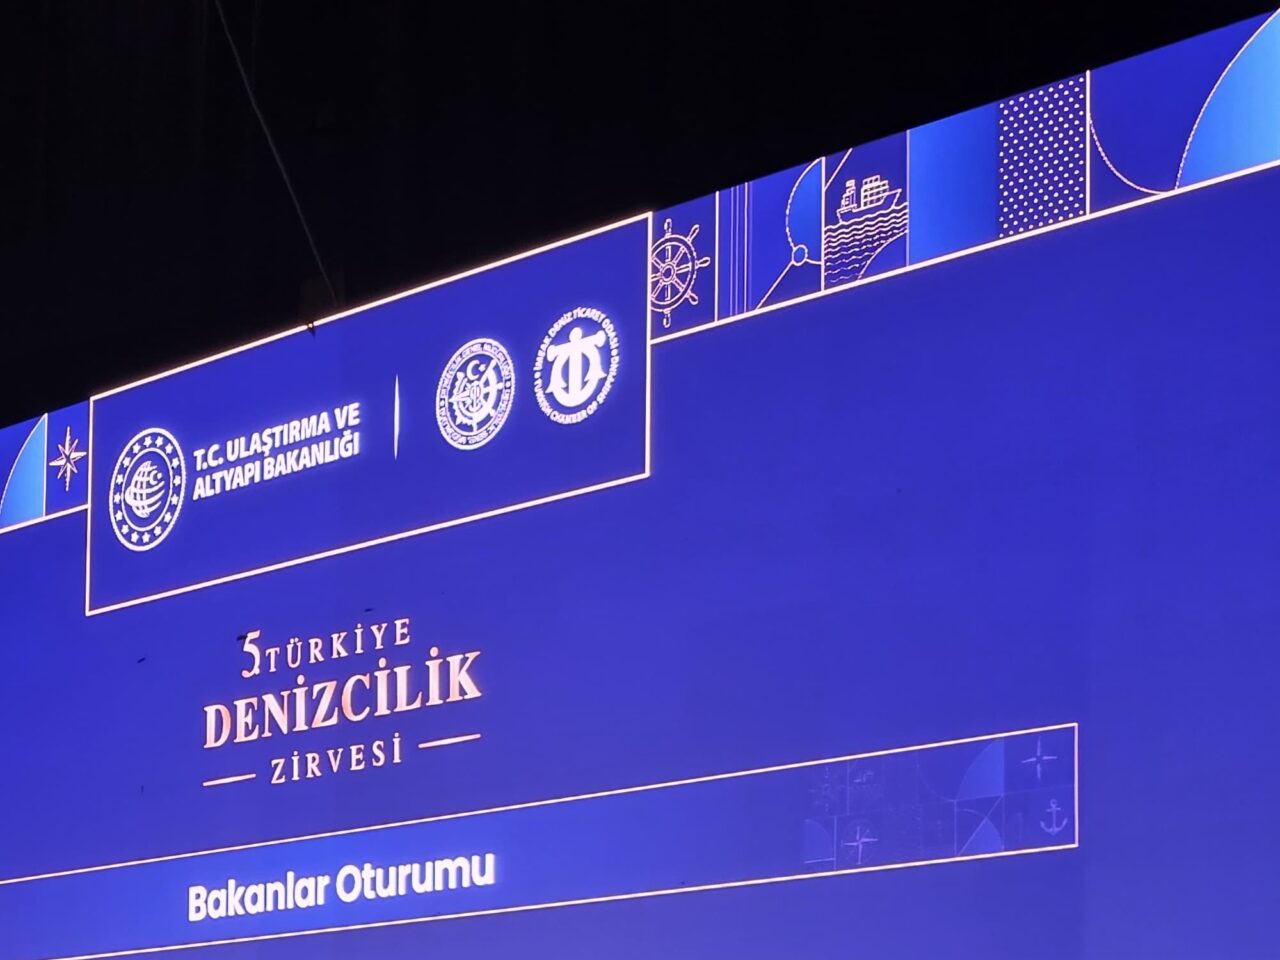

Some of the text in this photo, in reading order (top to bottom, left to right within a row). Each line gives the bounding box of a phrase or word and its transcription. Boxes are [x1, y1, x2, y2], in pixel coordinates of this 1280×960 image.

[602, 318, 619, 349] ODASI
[192, 429, 360, 501] ALTYAPI BAKANLIĞI
[193, 401, 361, 472] T.C. ULAŞTIRMA VE
[202, 646, 483, 749] DENİZCİLİK
[270, 732, 402, 785] ZİRVESİ
[187, 851, 496, 922] Bakanlar Oturumu
